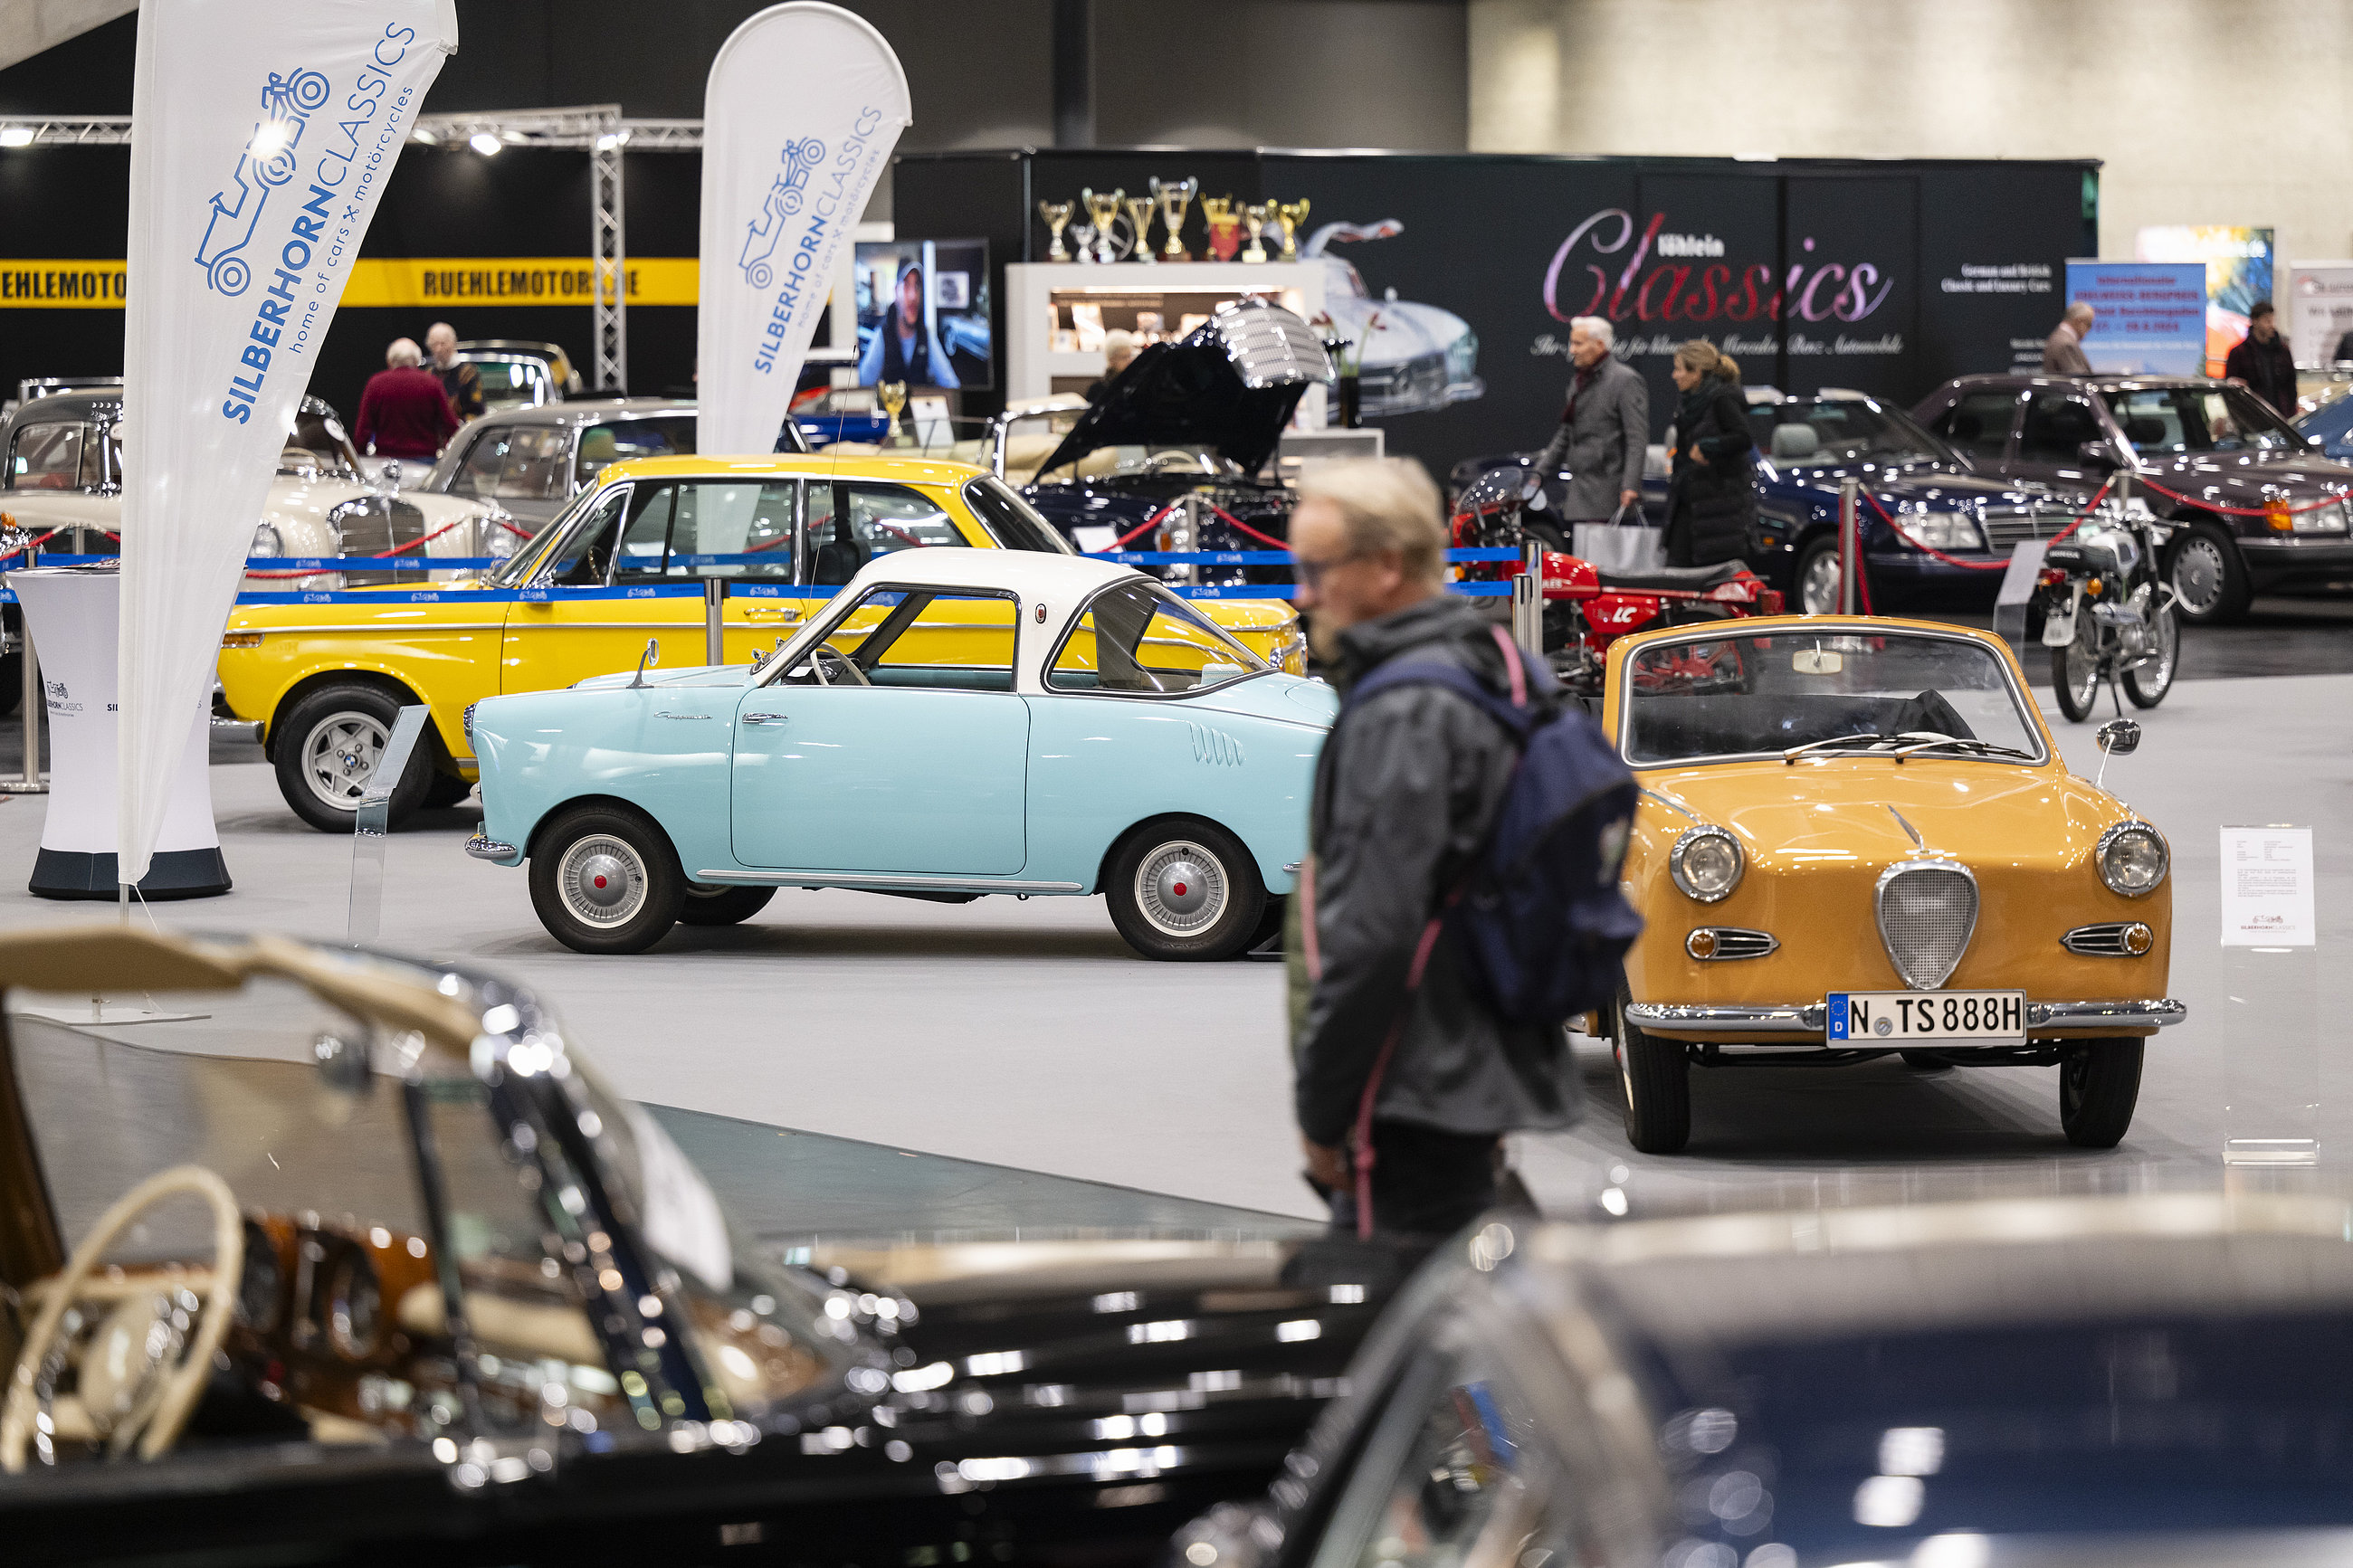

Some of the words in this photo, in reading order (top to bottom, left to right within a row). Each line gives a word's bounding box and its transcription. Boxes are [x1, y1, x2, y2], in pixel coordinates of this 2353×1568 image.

[223, 22, 414, 424] SILBERHORNCLASSICS
[289, 301, 319, 354] home
[316, 271, 330, 293] of
[327, 227, 349, 267] cars
[354, 86, 413, 202] motörcycles
[755, 106, 881, 374] SILBERHORNCLASSICS
[1543, 207, 1894, 323] Classics
[1834, 1021, 1843, 1032] D
[1850, 1000, 1869, 1033] N
